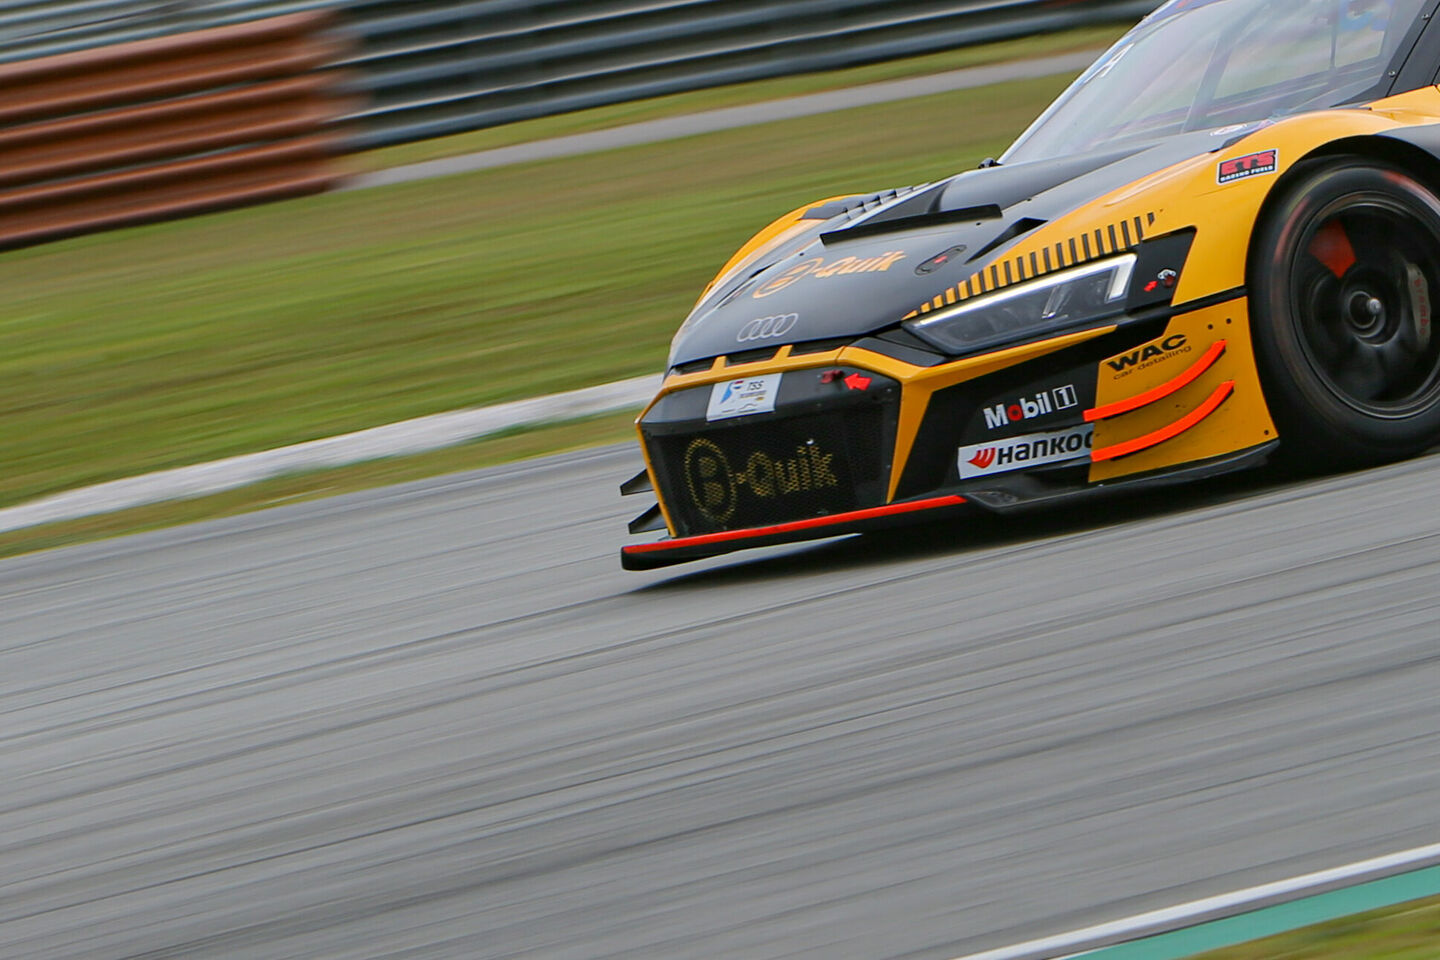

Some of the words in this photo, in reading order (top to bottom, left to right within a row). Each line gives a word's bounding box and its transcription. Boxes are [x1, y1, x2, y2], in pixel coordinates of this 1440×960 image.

[1220, 151, 1275, 176] ETS
[1107, 334, 1188, 372] WAC
[1113, 368, 1134, 380] car
[1137, 345, 1193, 371] detailing
[983, 391, 1053, 430] Mobil
[684, 438, 839, 523] B-Quik
